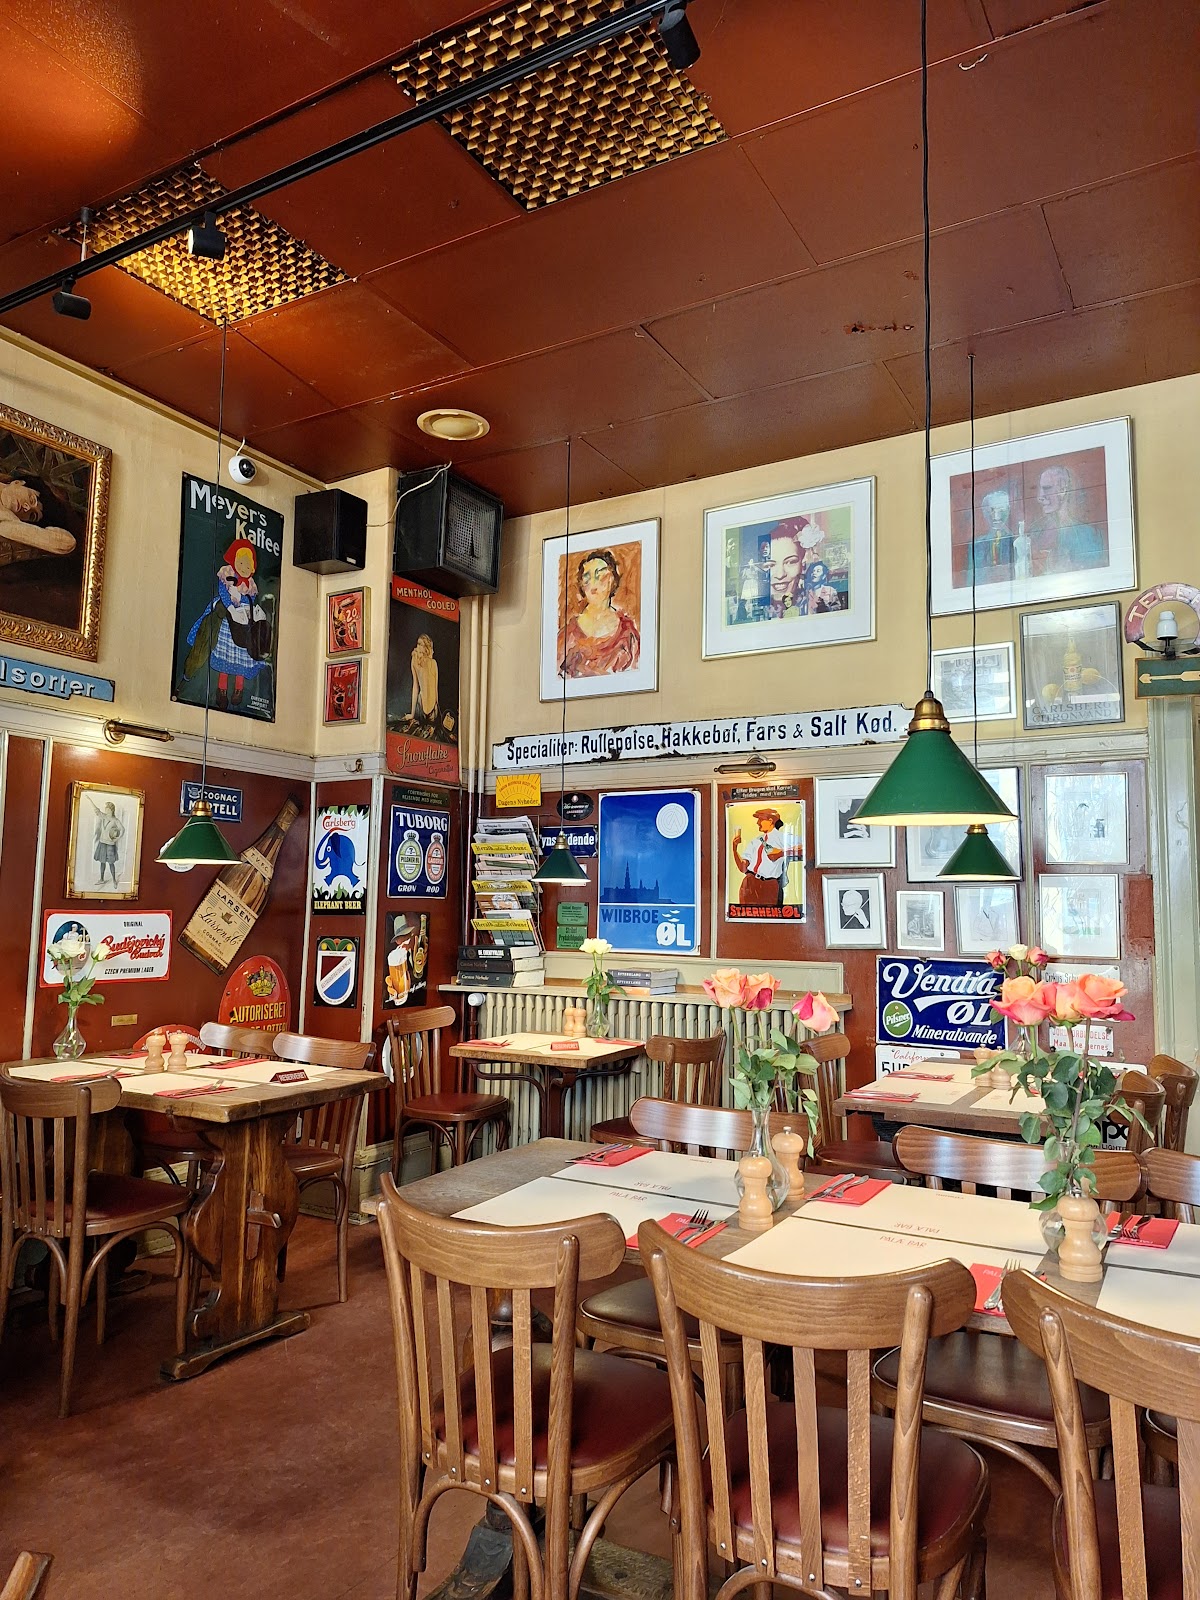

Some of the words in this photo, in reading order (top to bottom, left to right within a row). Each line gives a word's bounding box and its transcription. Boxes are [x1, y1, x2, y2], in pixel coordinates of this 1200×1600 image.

[190, 480, 267, 527] Meyer's
[235, 518, 280, 557] Kaffee
[396, 587, 432, 599] MENTHOL
[427, 600, 456, 610] COOLED
[1032, 702, 1111, 715] CARLSBERG
[1033, 709, 1112, 723] CITRONVAND
[662, 722, 741, 748] Hakkebøf,
[746, 721, 787, 742] Fars
[792, 724, 803, 738] &
[811, 714, 847, 738] Salt
[856, 710, 897, 735] Kød.
[397, 739, 448, 770] Snowflake
[203, 791, 237, 803] COGNAC
[188, 800, 237, 816] MTELL
[322, 815, 356, 831] Carlsberg
[396, 811, 448, 832] TUBORG
[540, 834, 557, 848] yns
[565, 833, 594, 846] dende
[397, 884, 417, 893] GRØN
[426, 885, 440, 894] RØD
[216, 889, 251, 923] LARSEN
[313, 900, 343, 910] ELEPHANT
[344, 900, 362, 910] BEER
[782, 905, 801, 918] ØL
[601, 908, 659, 924] WIIBROE
[656, 921, 692, 947] ØL
[883, 962, 998, 999] Vendia
[229, 1001, 287, 1024] AUTORISERET
[885, 1011, 911, 1026] Pilsner
[946, 1000, 992, 1026] ØL
[911, 1024, 998, 1045] Mineralvande
[1053, 1039, 1067, 1047] Maa
[907, 1239, 928, 1248] BAR
